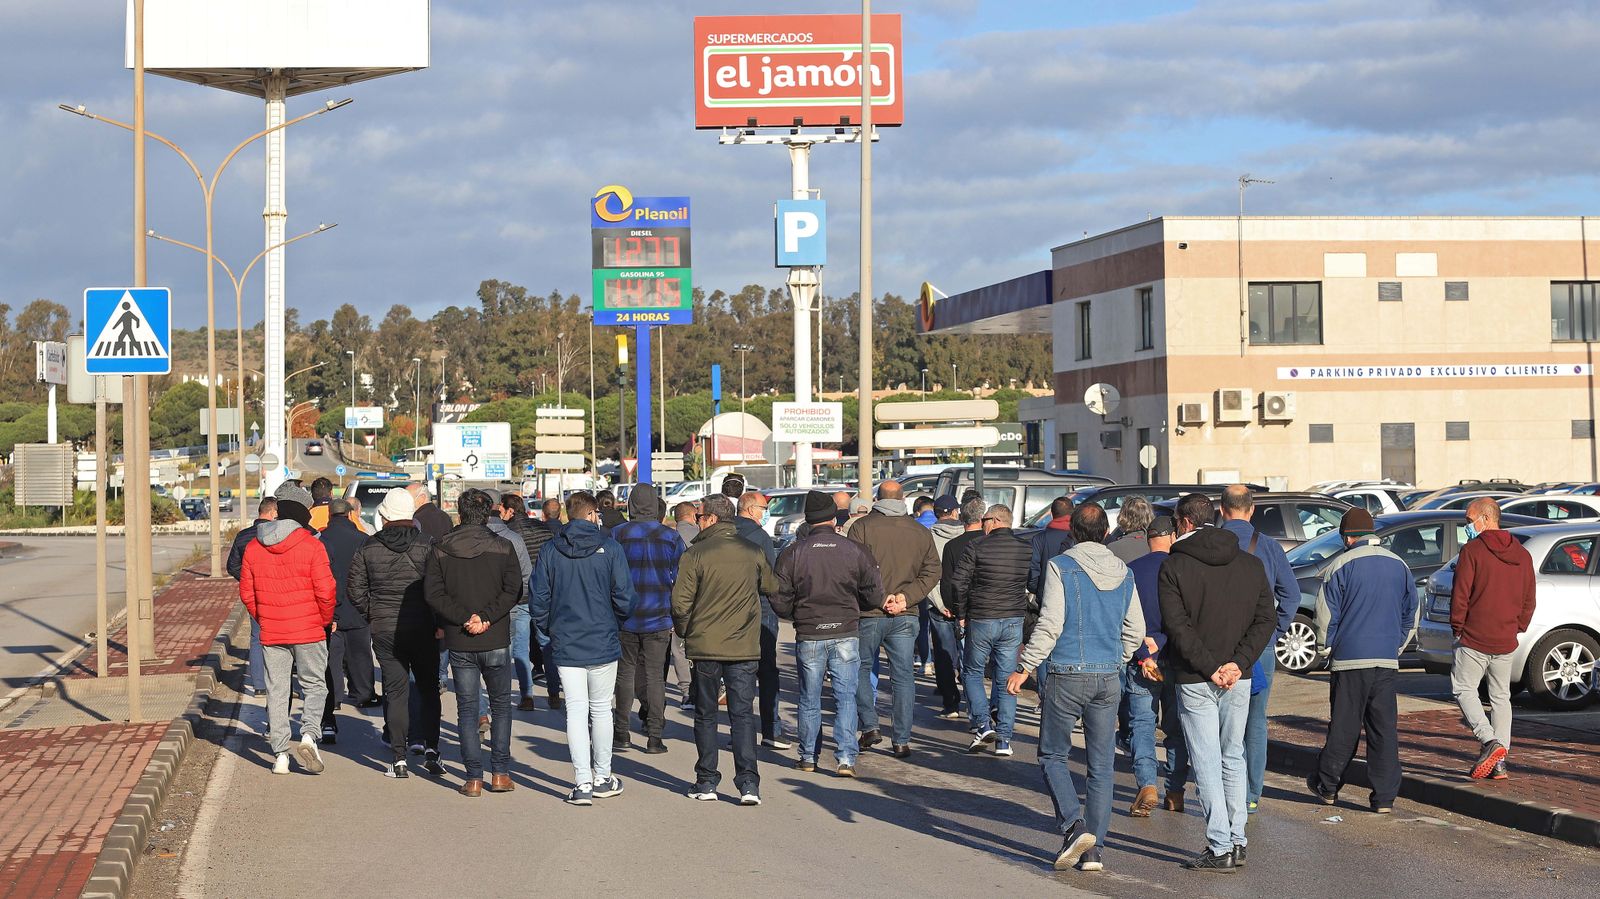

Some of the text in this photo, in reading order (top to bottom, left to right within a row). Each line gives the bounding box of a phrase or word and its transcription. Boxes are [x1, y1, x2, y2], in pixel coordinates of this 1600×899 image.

[707, 32, 813, 44] SUPERMERCADOS
[716, 52, 882, 95] el jamón
[635, 207, 688, 220] Plenoil
[784, 211, 819, 253] P
[616, 312, 670, 322] 24 HORAS
[1310, 365, 1559, 378] PARKING PRIVADO EXCLUSIVO CLIENTES
[999, 432, 1023, 441] cDo
